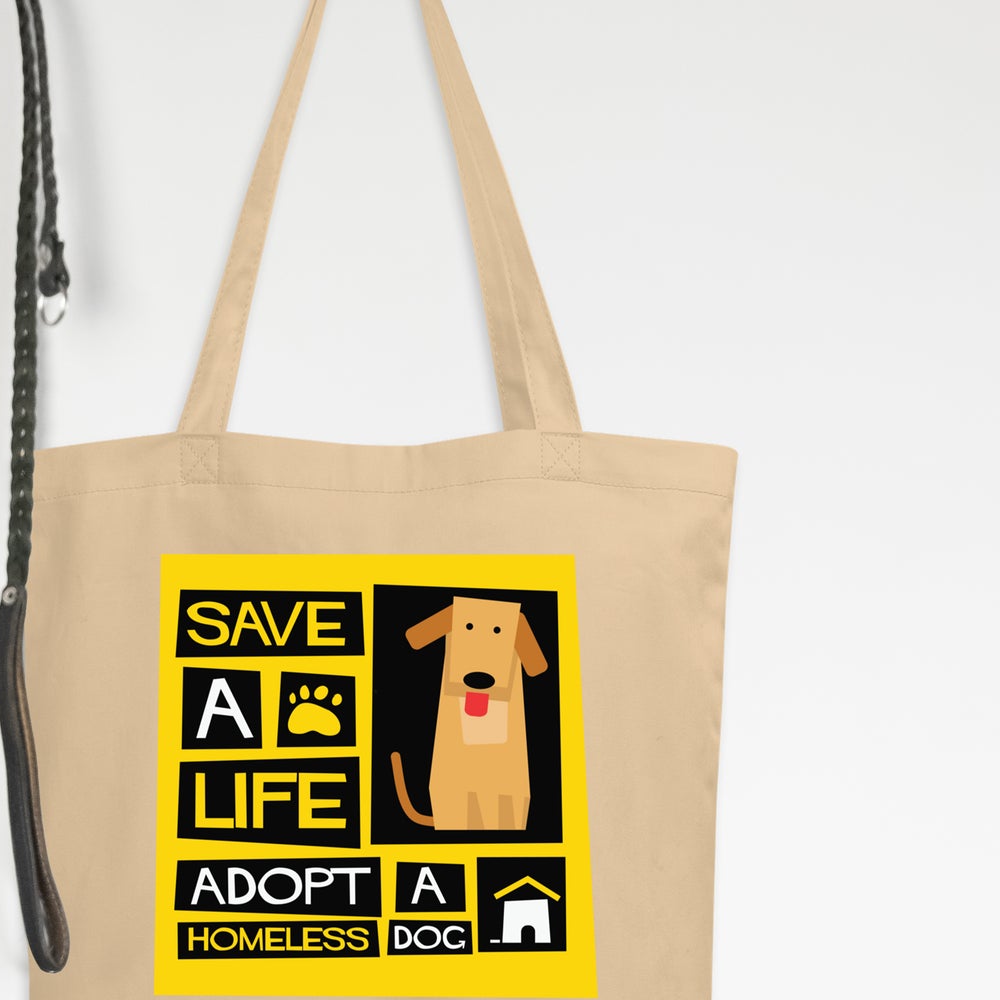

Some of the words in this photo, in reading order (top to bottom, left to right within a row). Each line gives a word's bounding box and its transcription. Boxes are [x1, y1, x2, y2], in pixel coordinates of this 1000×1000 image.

[187, 601, 345, 646] SAVE
[196, 678, 253, 738] A
[195, 773, 346, 828] LIFE
[191, 867, 371, 904] ADOPT
[411, 867, 446, 904] A
[189, 927, 369, 951] HOMELESS
[394, 926, 465, 949] DOG
